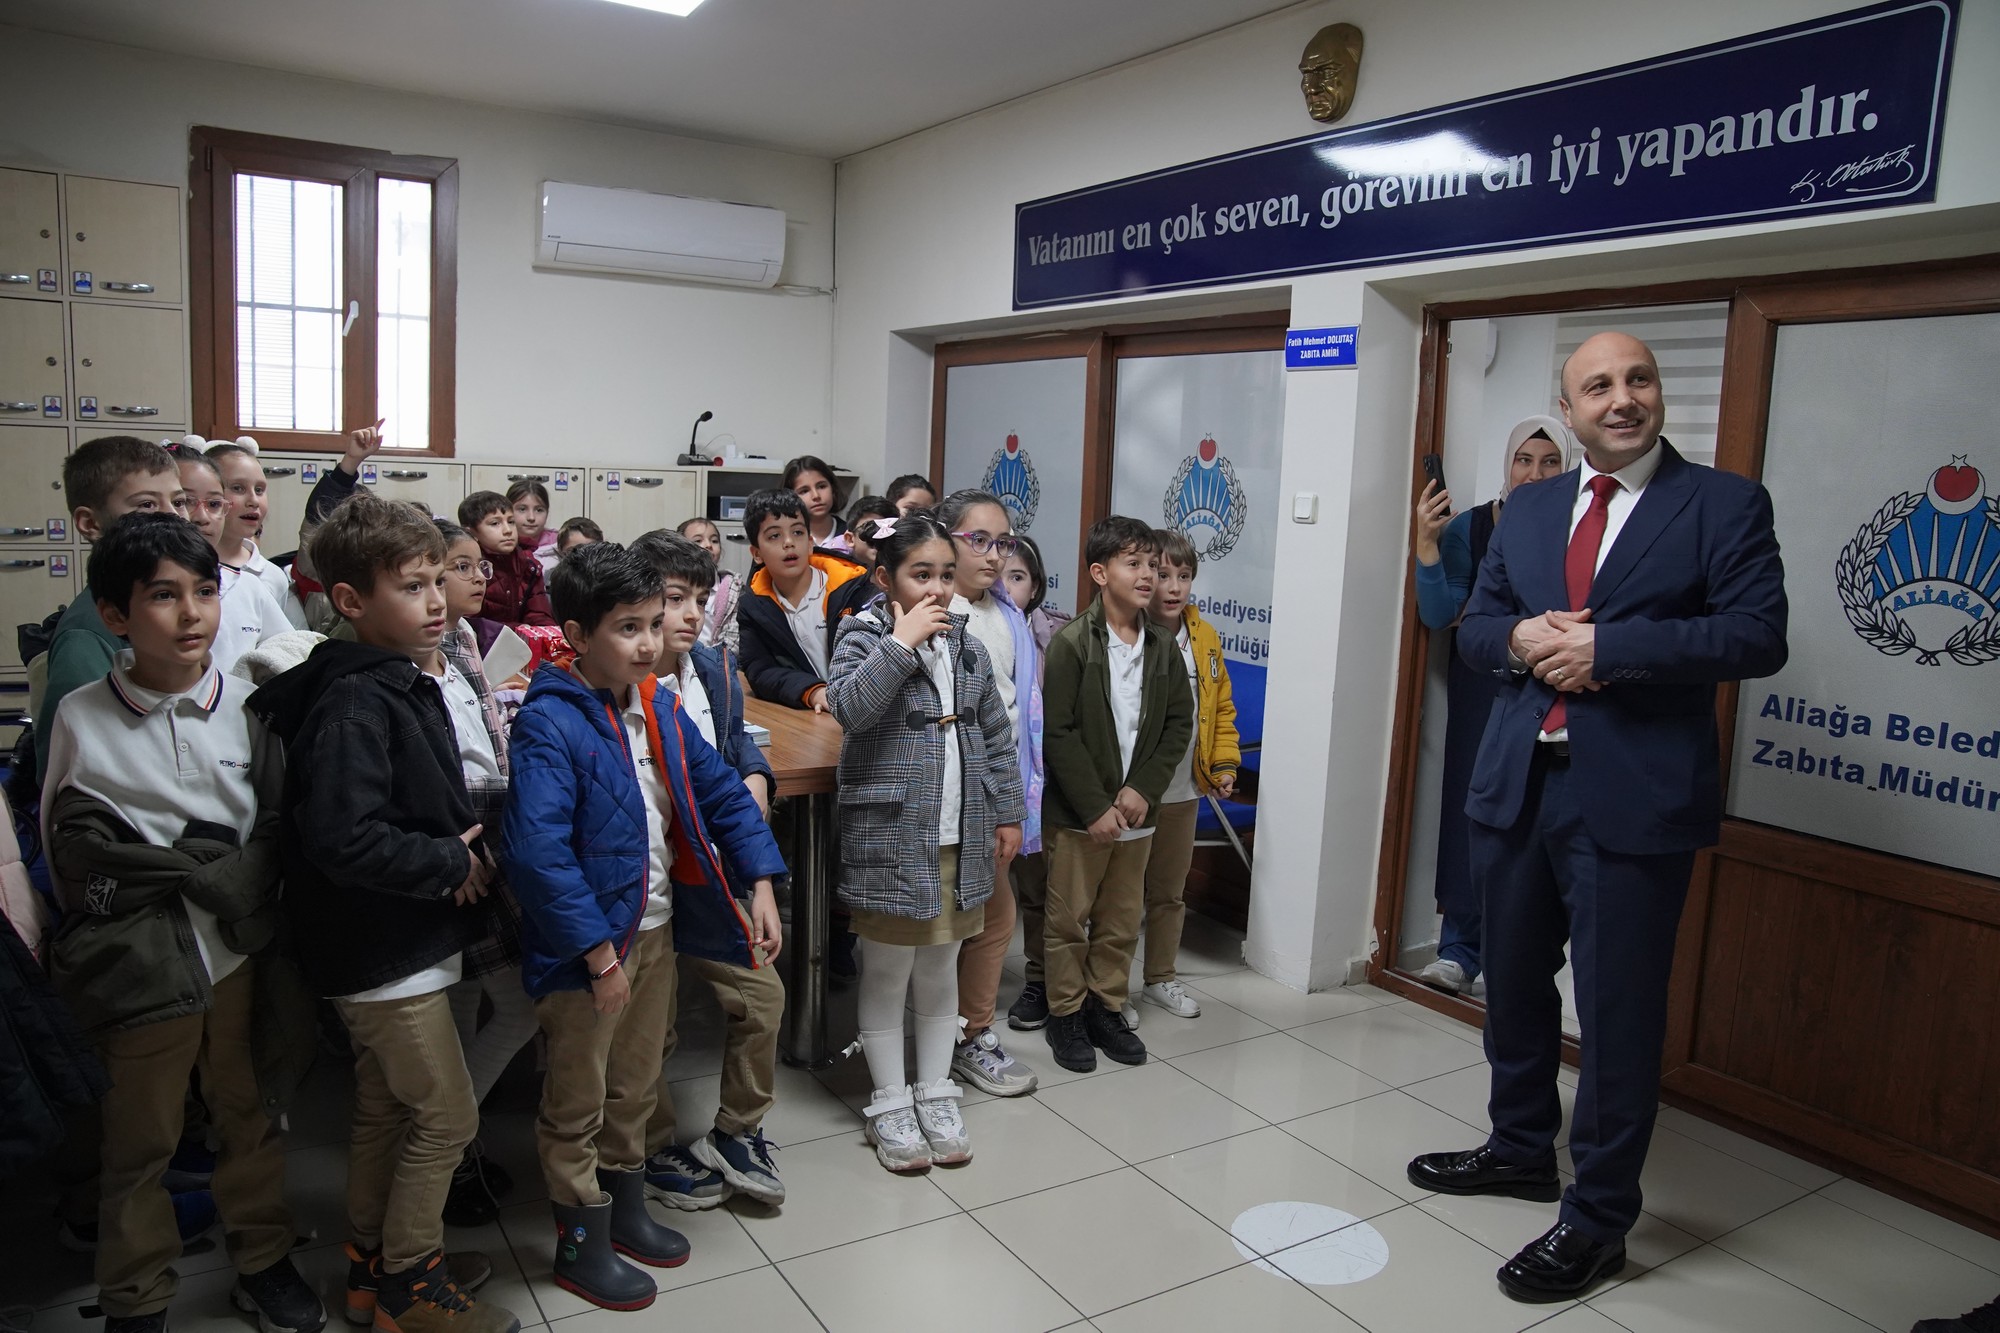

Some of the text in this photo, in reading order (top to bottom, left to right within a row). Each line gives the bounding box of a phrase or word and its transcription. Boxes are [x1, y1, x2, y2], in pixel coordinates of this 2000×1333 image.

[1028, 229, 1114, 266] Vatanını
[1122, 221, 1151, 250] en
[1160, 203, 1207, 255] çok
[1214, 194, 1310, 236] seven,
[1481, 152, 1532, 192] en
[1548, 127, 1601, 194] iyi
[1613, 84, 1878, 186] yapandır.
[1288, 334, 1354, 347] Fatih Mehmet DOLUTAŞ
[1300, 347, 1339, 359] ZABITA AMİRİ
[1186, 512, 1221, 532] ALİAĞA
[1188, 593, 1272, 624] Belediyesi
[1893, 584, 1985, 621] ALİAĞA
[1760, 693, 2000, 759] Aliağa Beled
[1752, 739, 1864, 785] Zabıta
